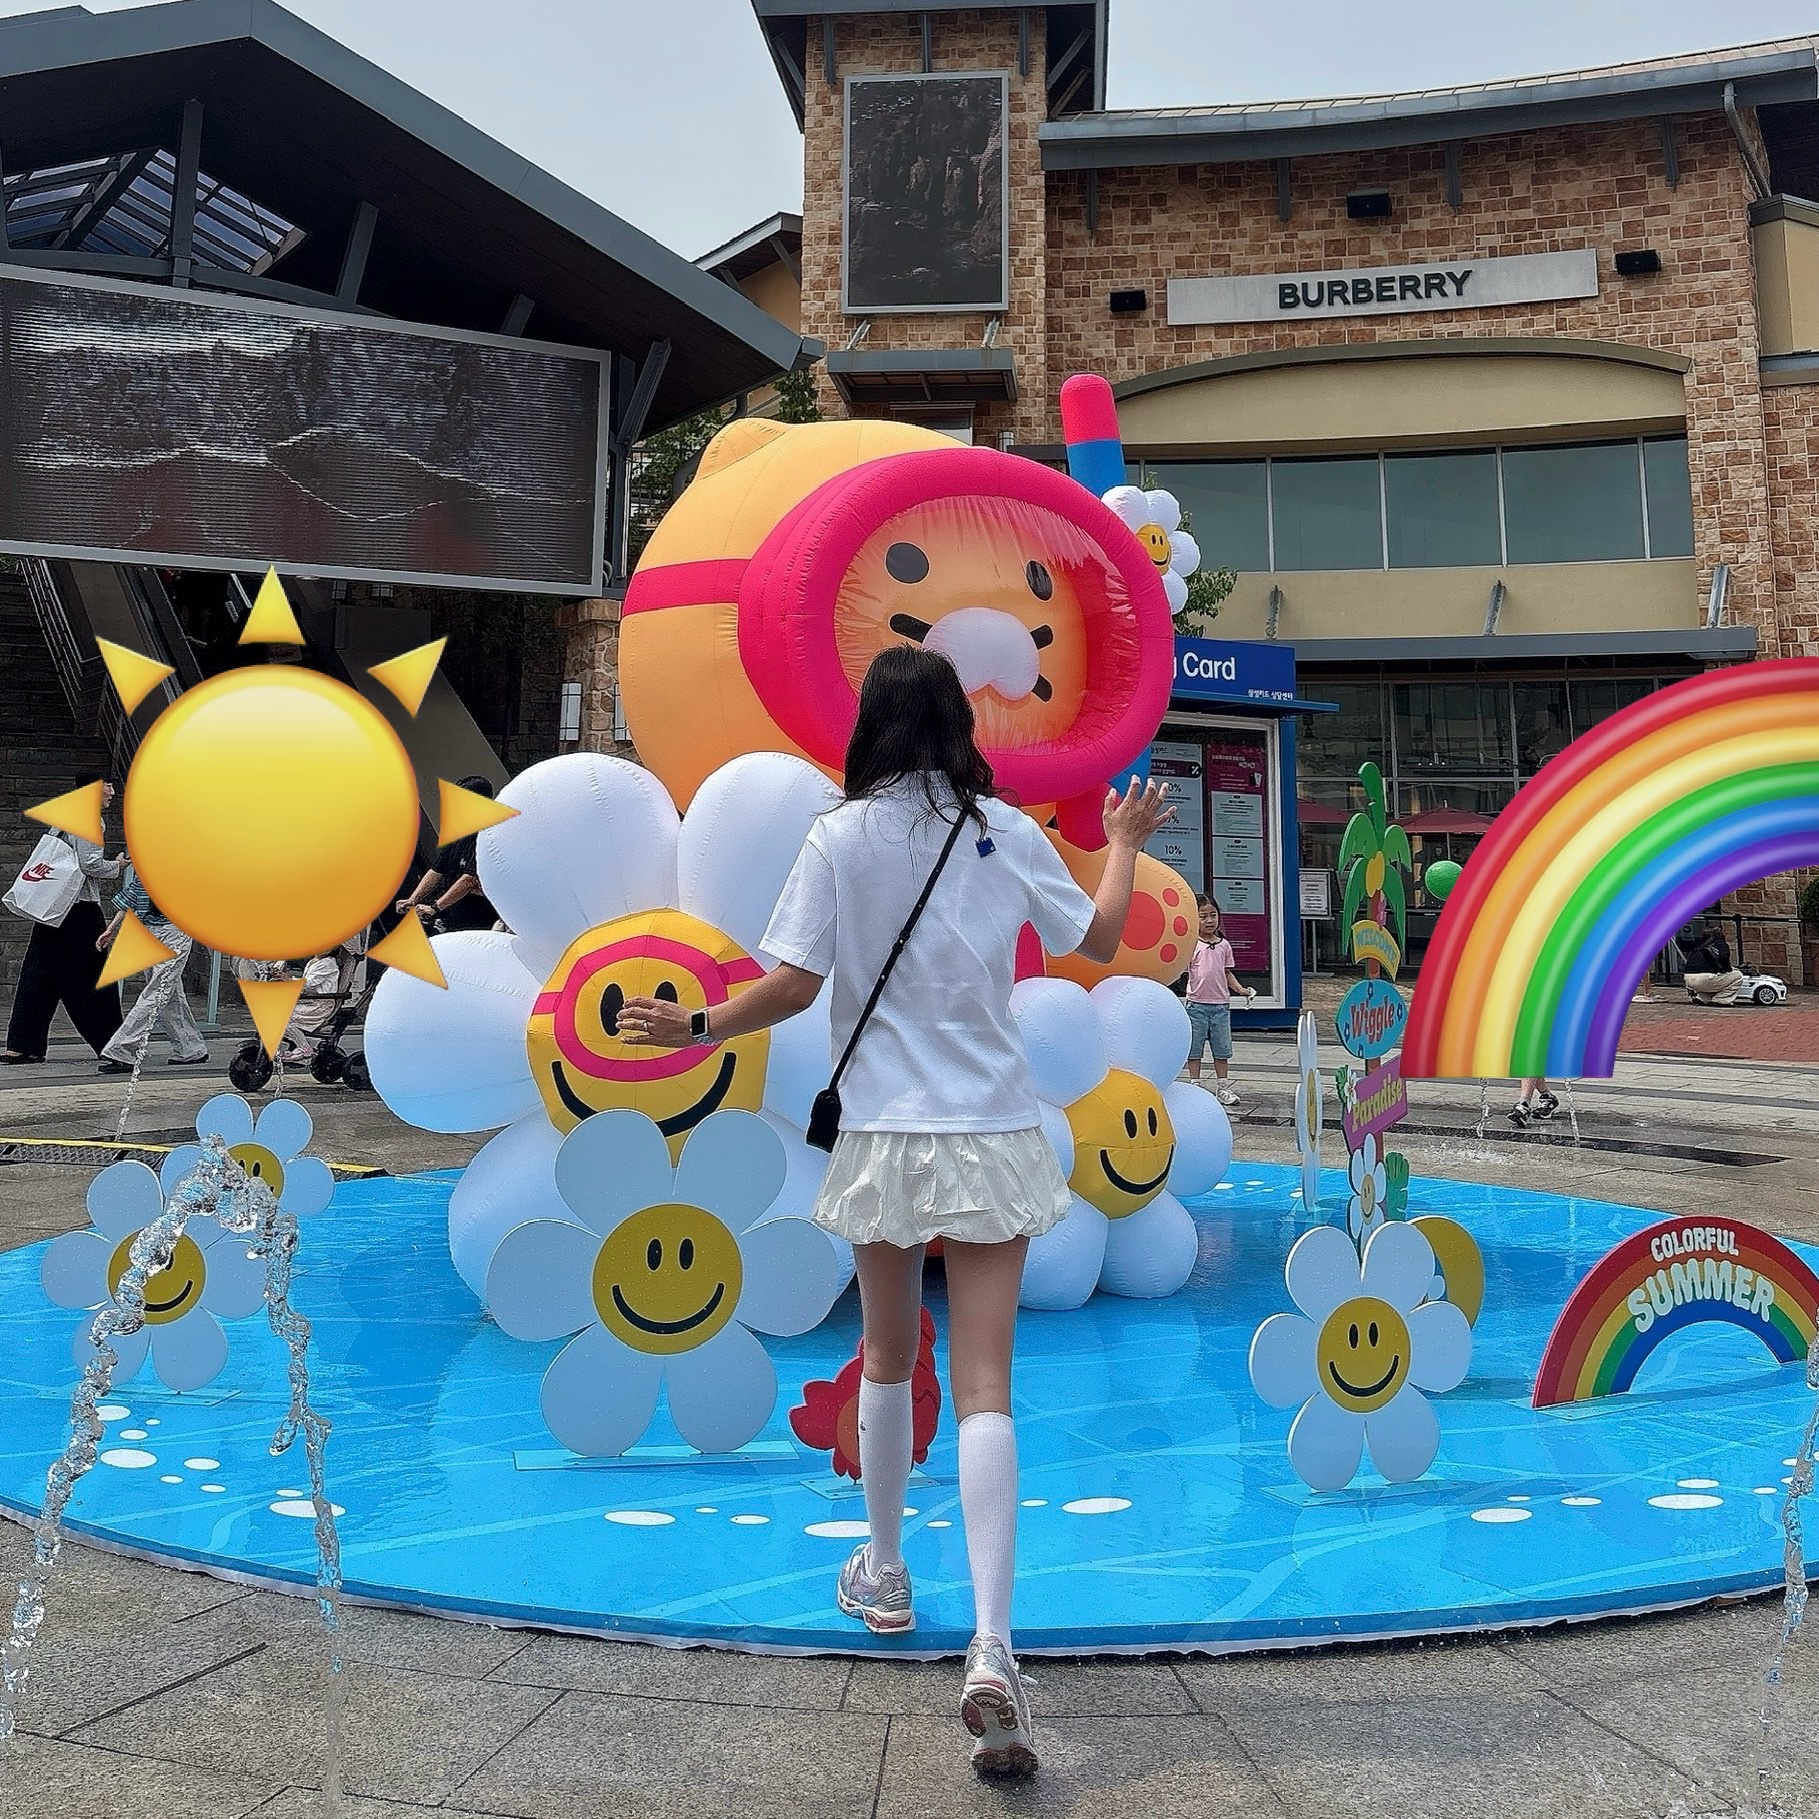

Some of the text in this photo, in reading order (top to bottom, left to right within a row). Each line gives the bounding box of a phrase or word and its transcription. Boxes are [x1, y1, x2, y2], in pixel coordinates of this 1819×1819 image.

[1278, 269, 1473, 309] BURBERRY
[1183, 652, 1235, 680] Card
[1165, 845, 1182, 855] 10%
[1351, 996, 1395, 1045] Wiggle
[1351, 1073, 1403, 1133] Paradise
[1650, 1227, 1739, 1262] COLORFUL
[1627, 1257, 1775, 1333] SUMMER
